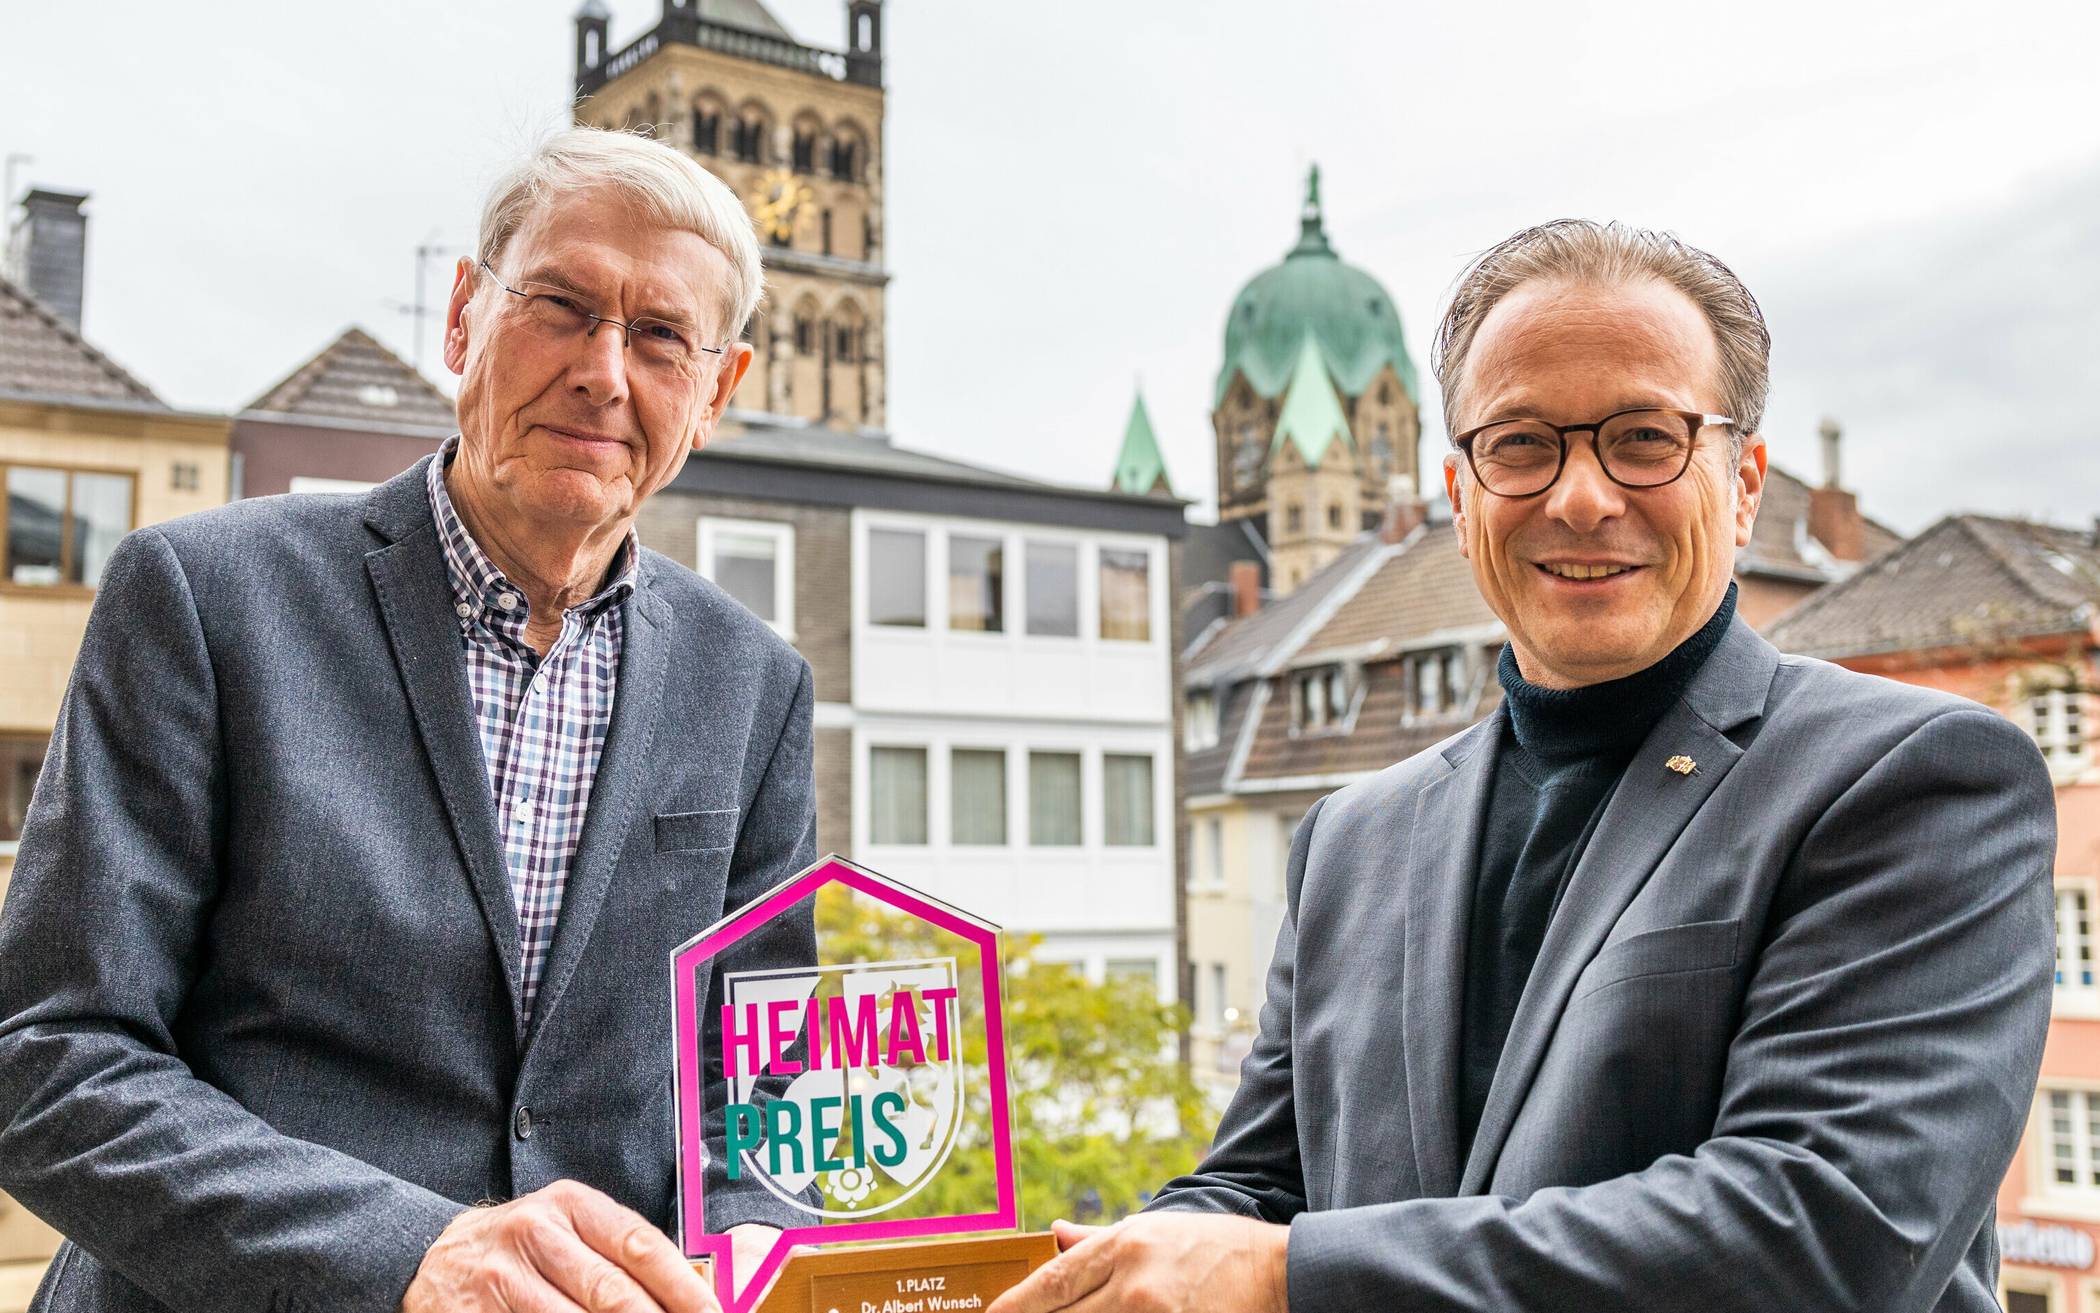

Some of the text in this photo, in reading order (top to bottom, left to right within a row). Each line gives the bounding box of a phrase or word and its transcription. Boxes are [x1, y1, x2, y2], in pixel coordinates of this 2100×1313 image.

[721, 987, 957, 1079] HEIMAT
[725, 1091, 908, 1180] PREIS
[861, 1294, 982, 1313] Dr. Albert Wunsch
[896, 1277, 946, 1293] 1. PLATZ
